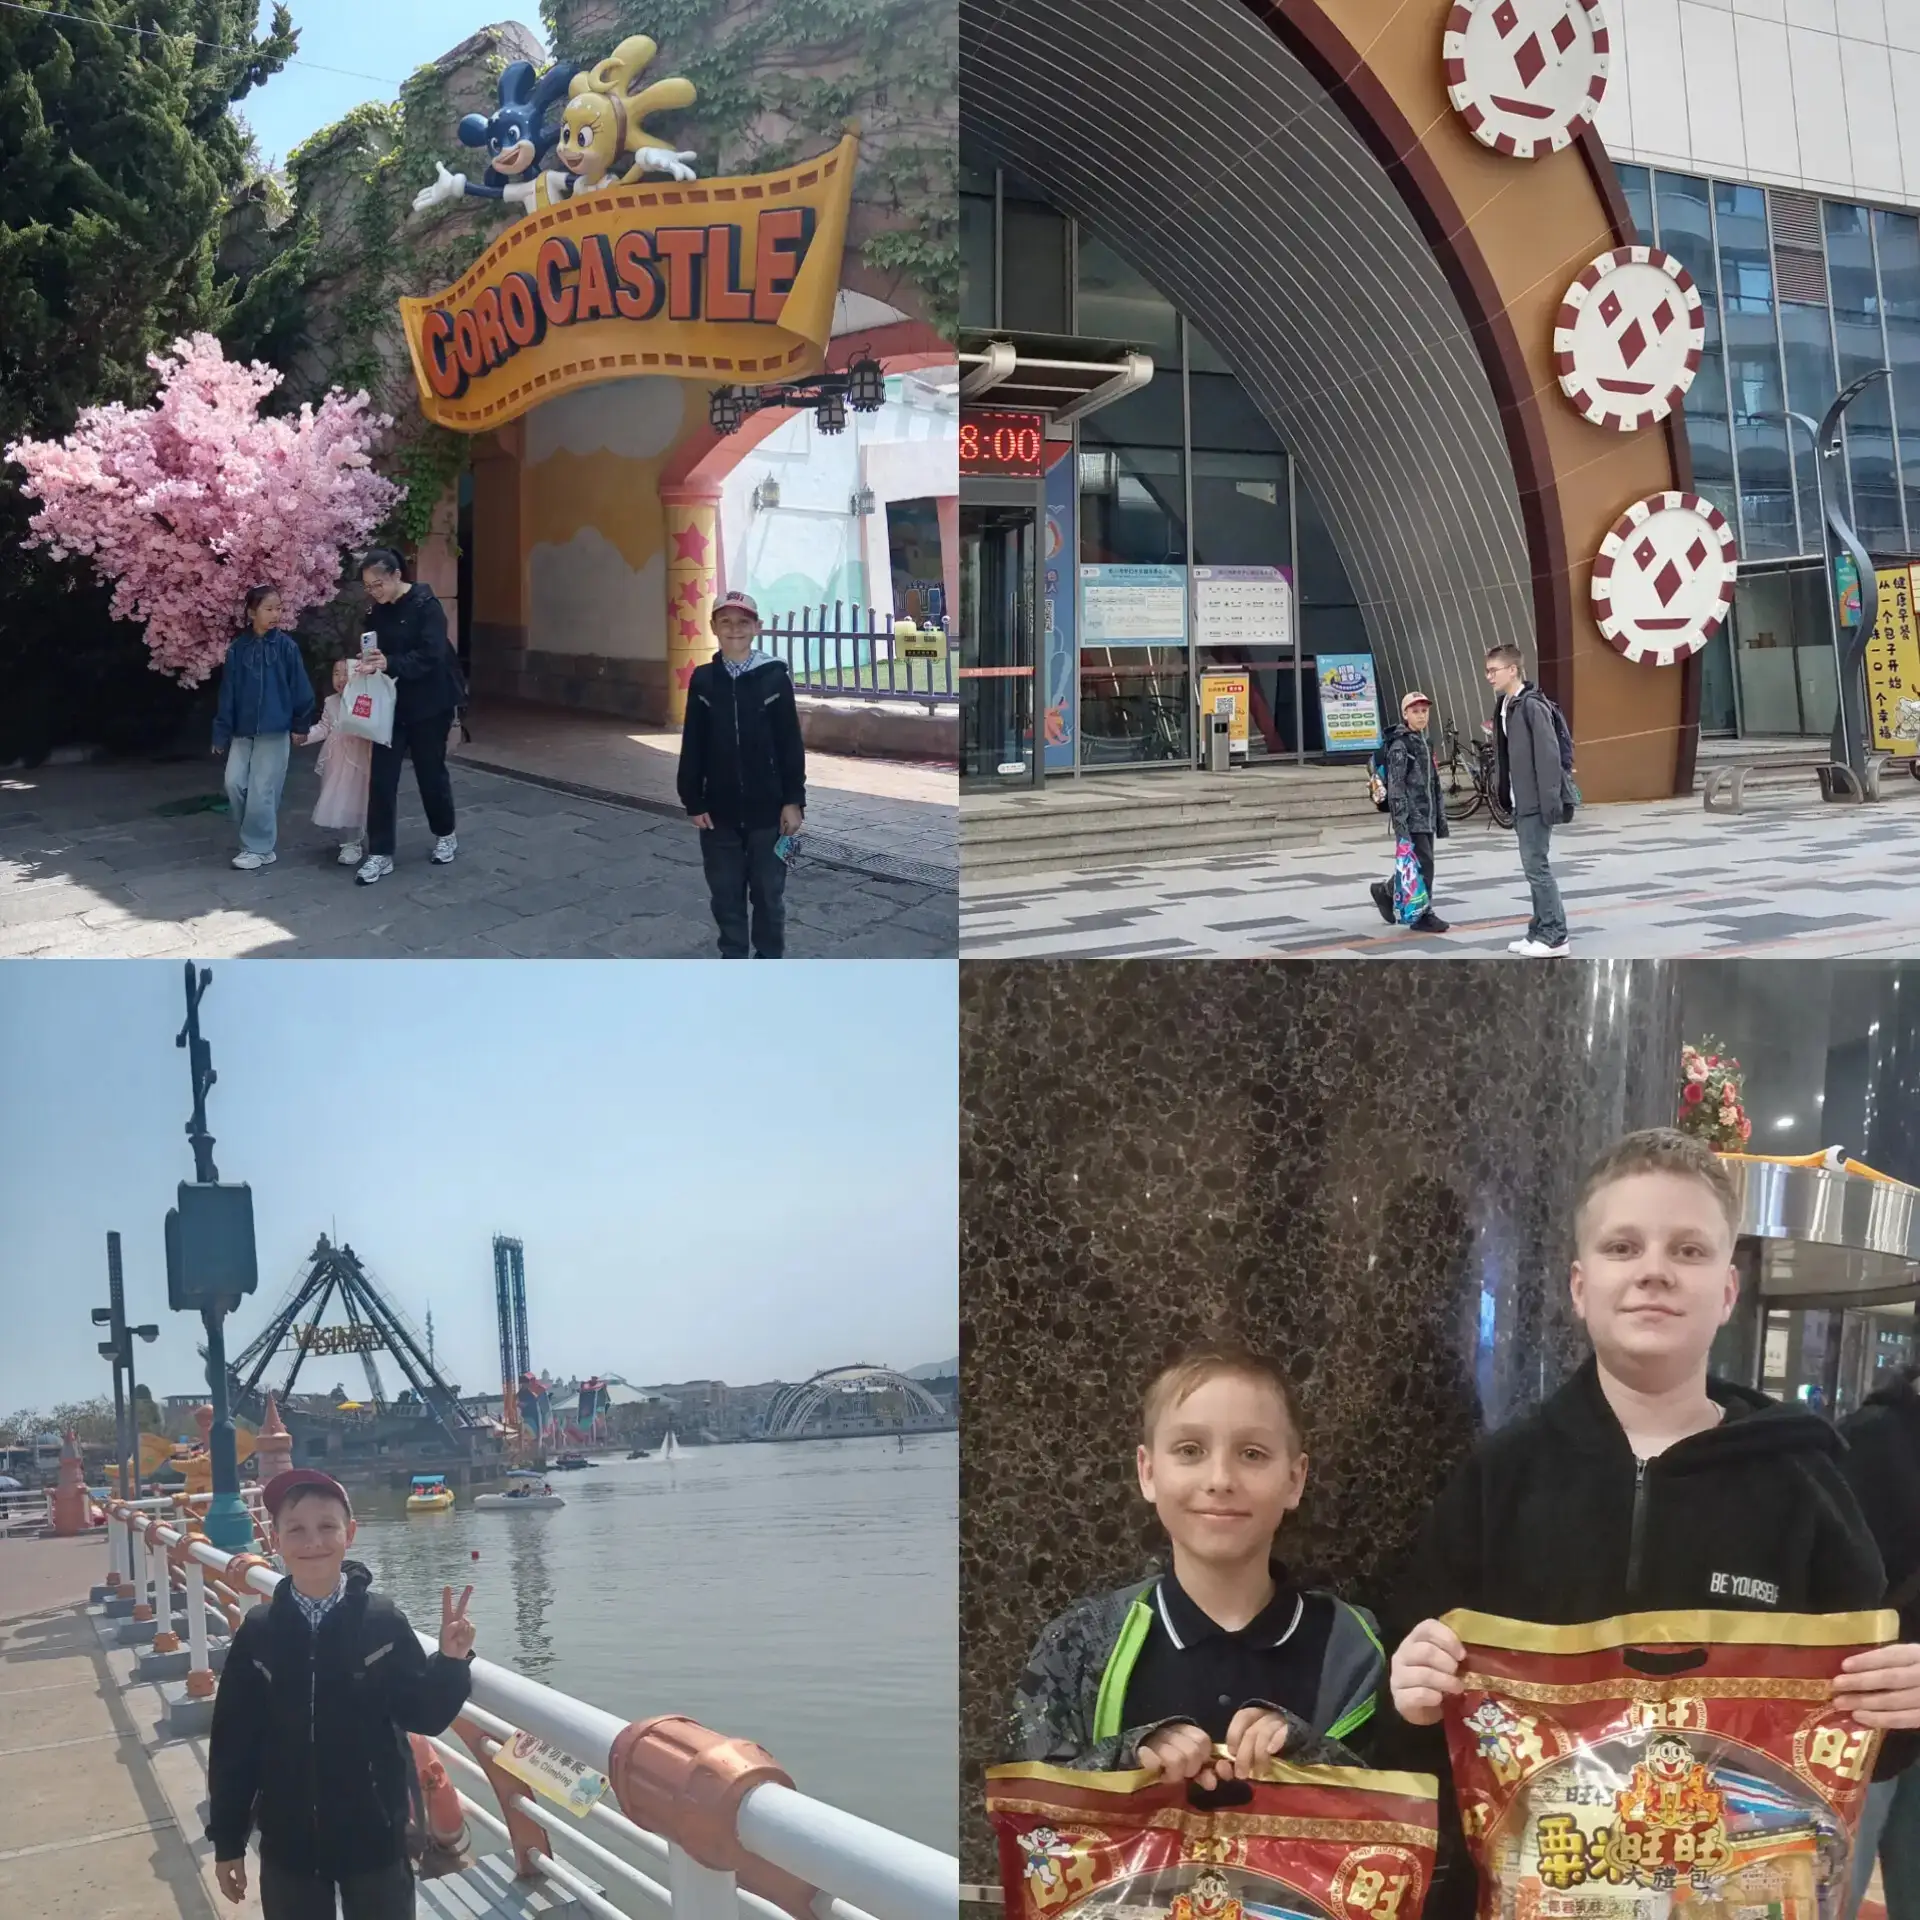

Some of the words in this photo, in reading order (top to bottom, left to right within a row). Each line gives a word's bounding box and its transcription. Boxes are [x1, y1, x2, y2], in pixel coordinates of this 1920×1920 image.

[422, 271, 547, 398] CORO
[537, 207, 815, 326] CASTLE
[1710, 1572, 1730, 1594] BE
[541, 1761, 573, 1788] Climbing
